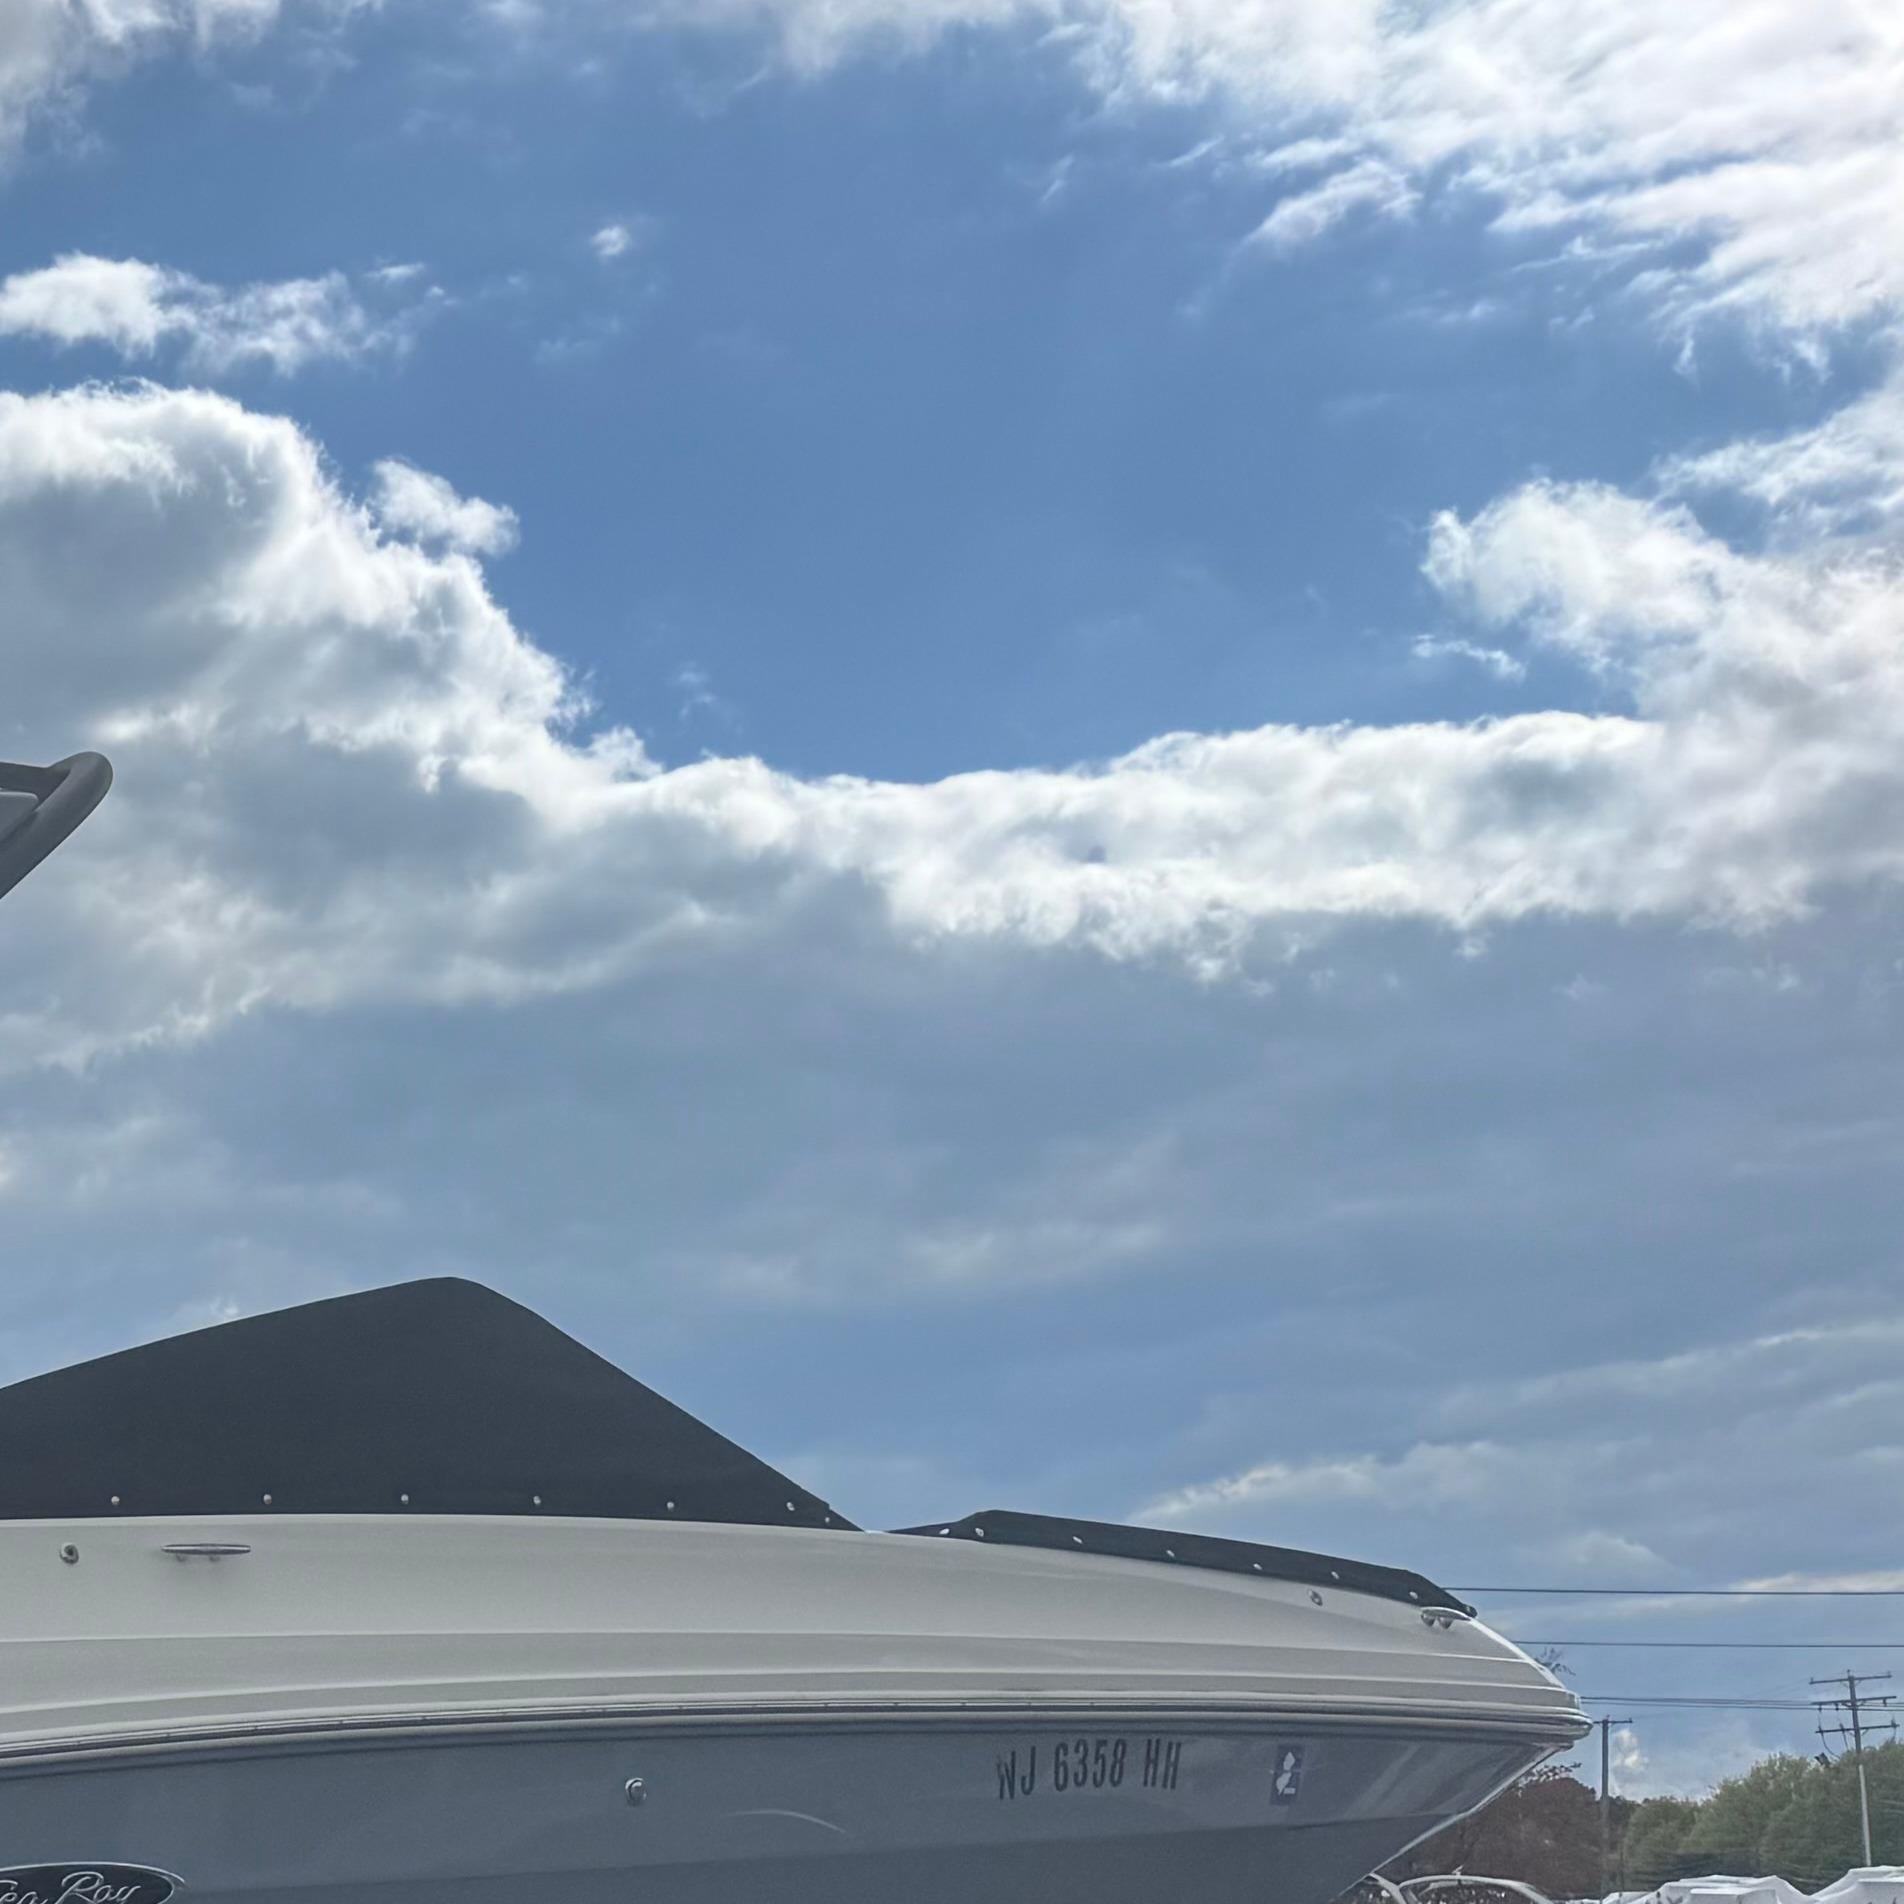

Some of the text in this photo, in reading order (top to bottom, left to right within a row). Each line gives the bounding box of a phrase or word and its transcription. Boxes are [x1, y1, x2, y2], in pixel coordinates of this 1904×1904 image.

[996, 1738, 1182, 1800] NJ 6358 HH
